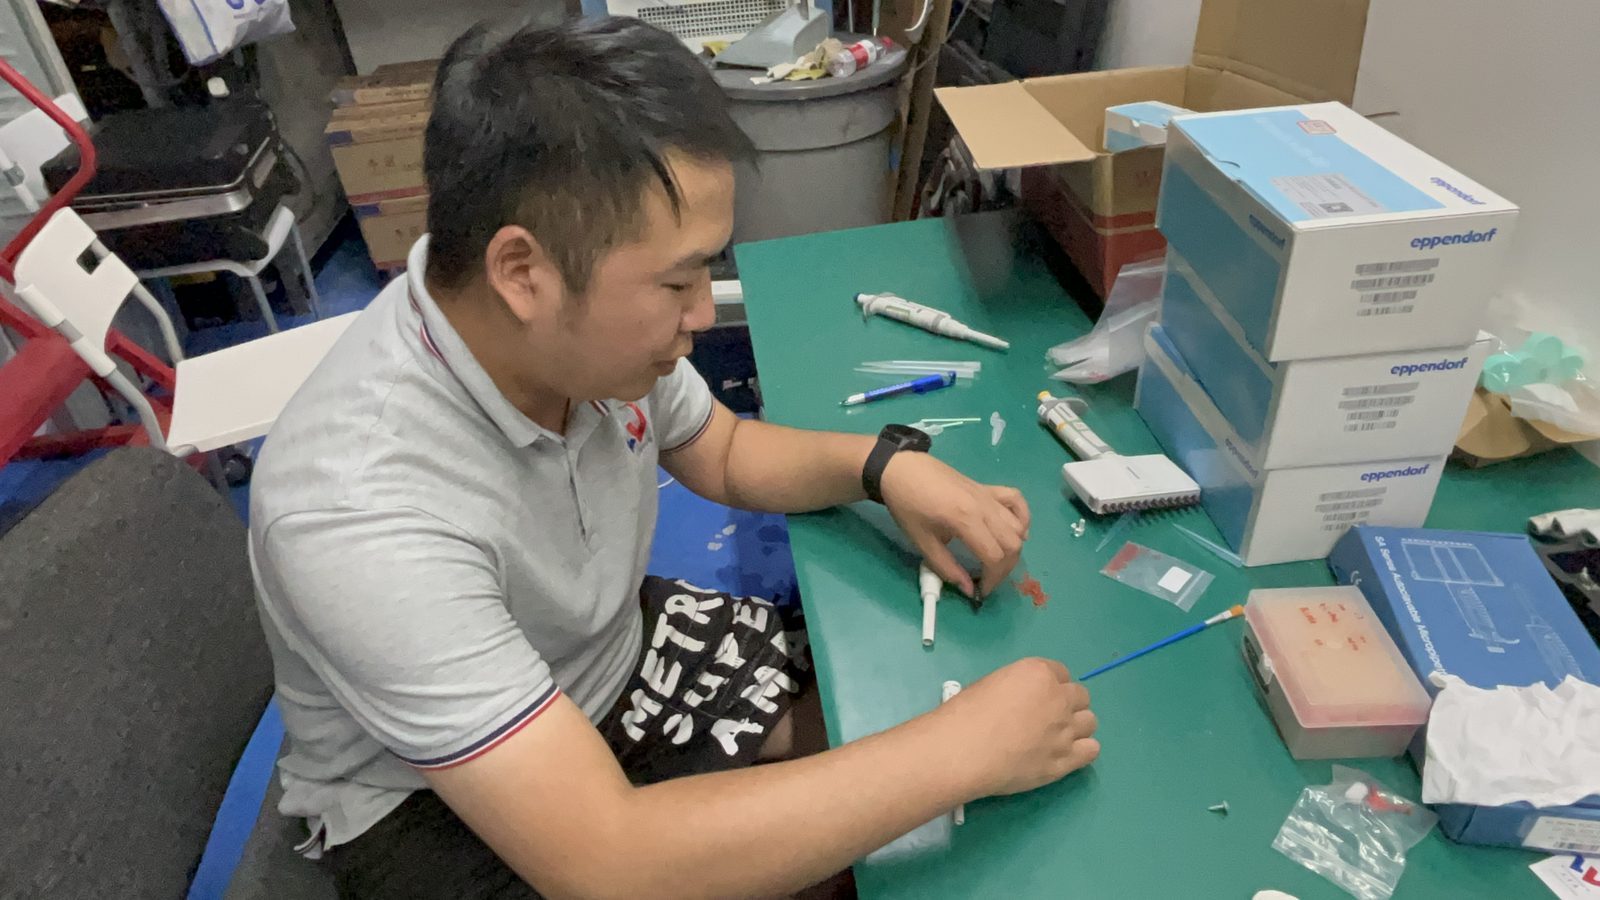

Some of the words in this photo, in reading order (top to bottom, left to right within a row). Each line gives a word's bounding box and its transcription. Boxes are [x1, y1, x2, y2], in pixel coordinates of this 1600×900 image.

[1410, 228, 1498, 250] eppendorf
[1391, 357, 1469, 376] eppendorf
[1360, 464, 1430, 483] eppendorf
[663, 596, 774, 744] SUPE
